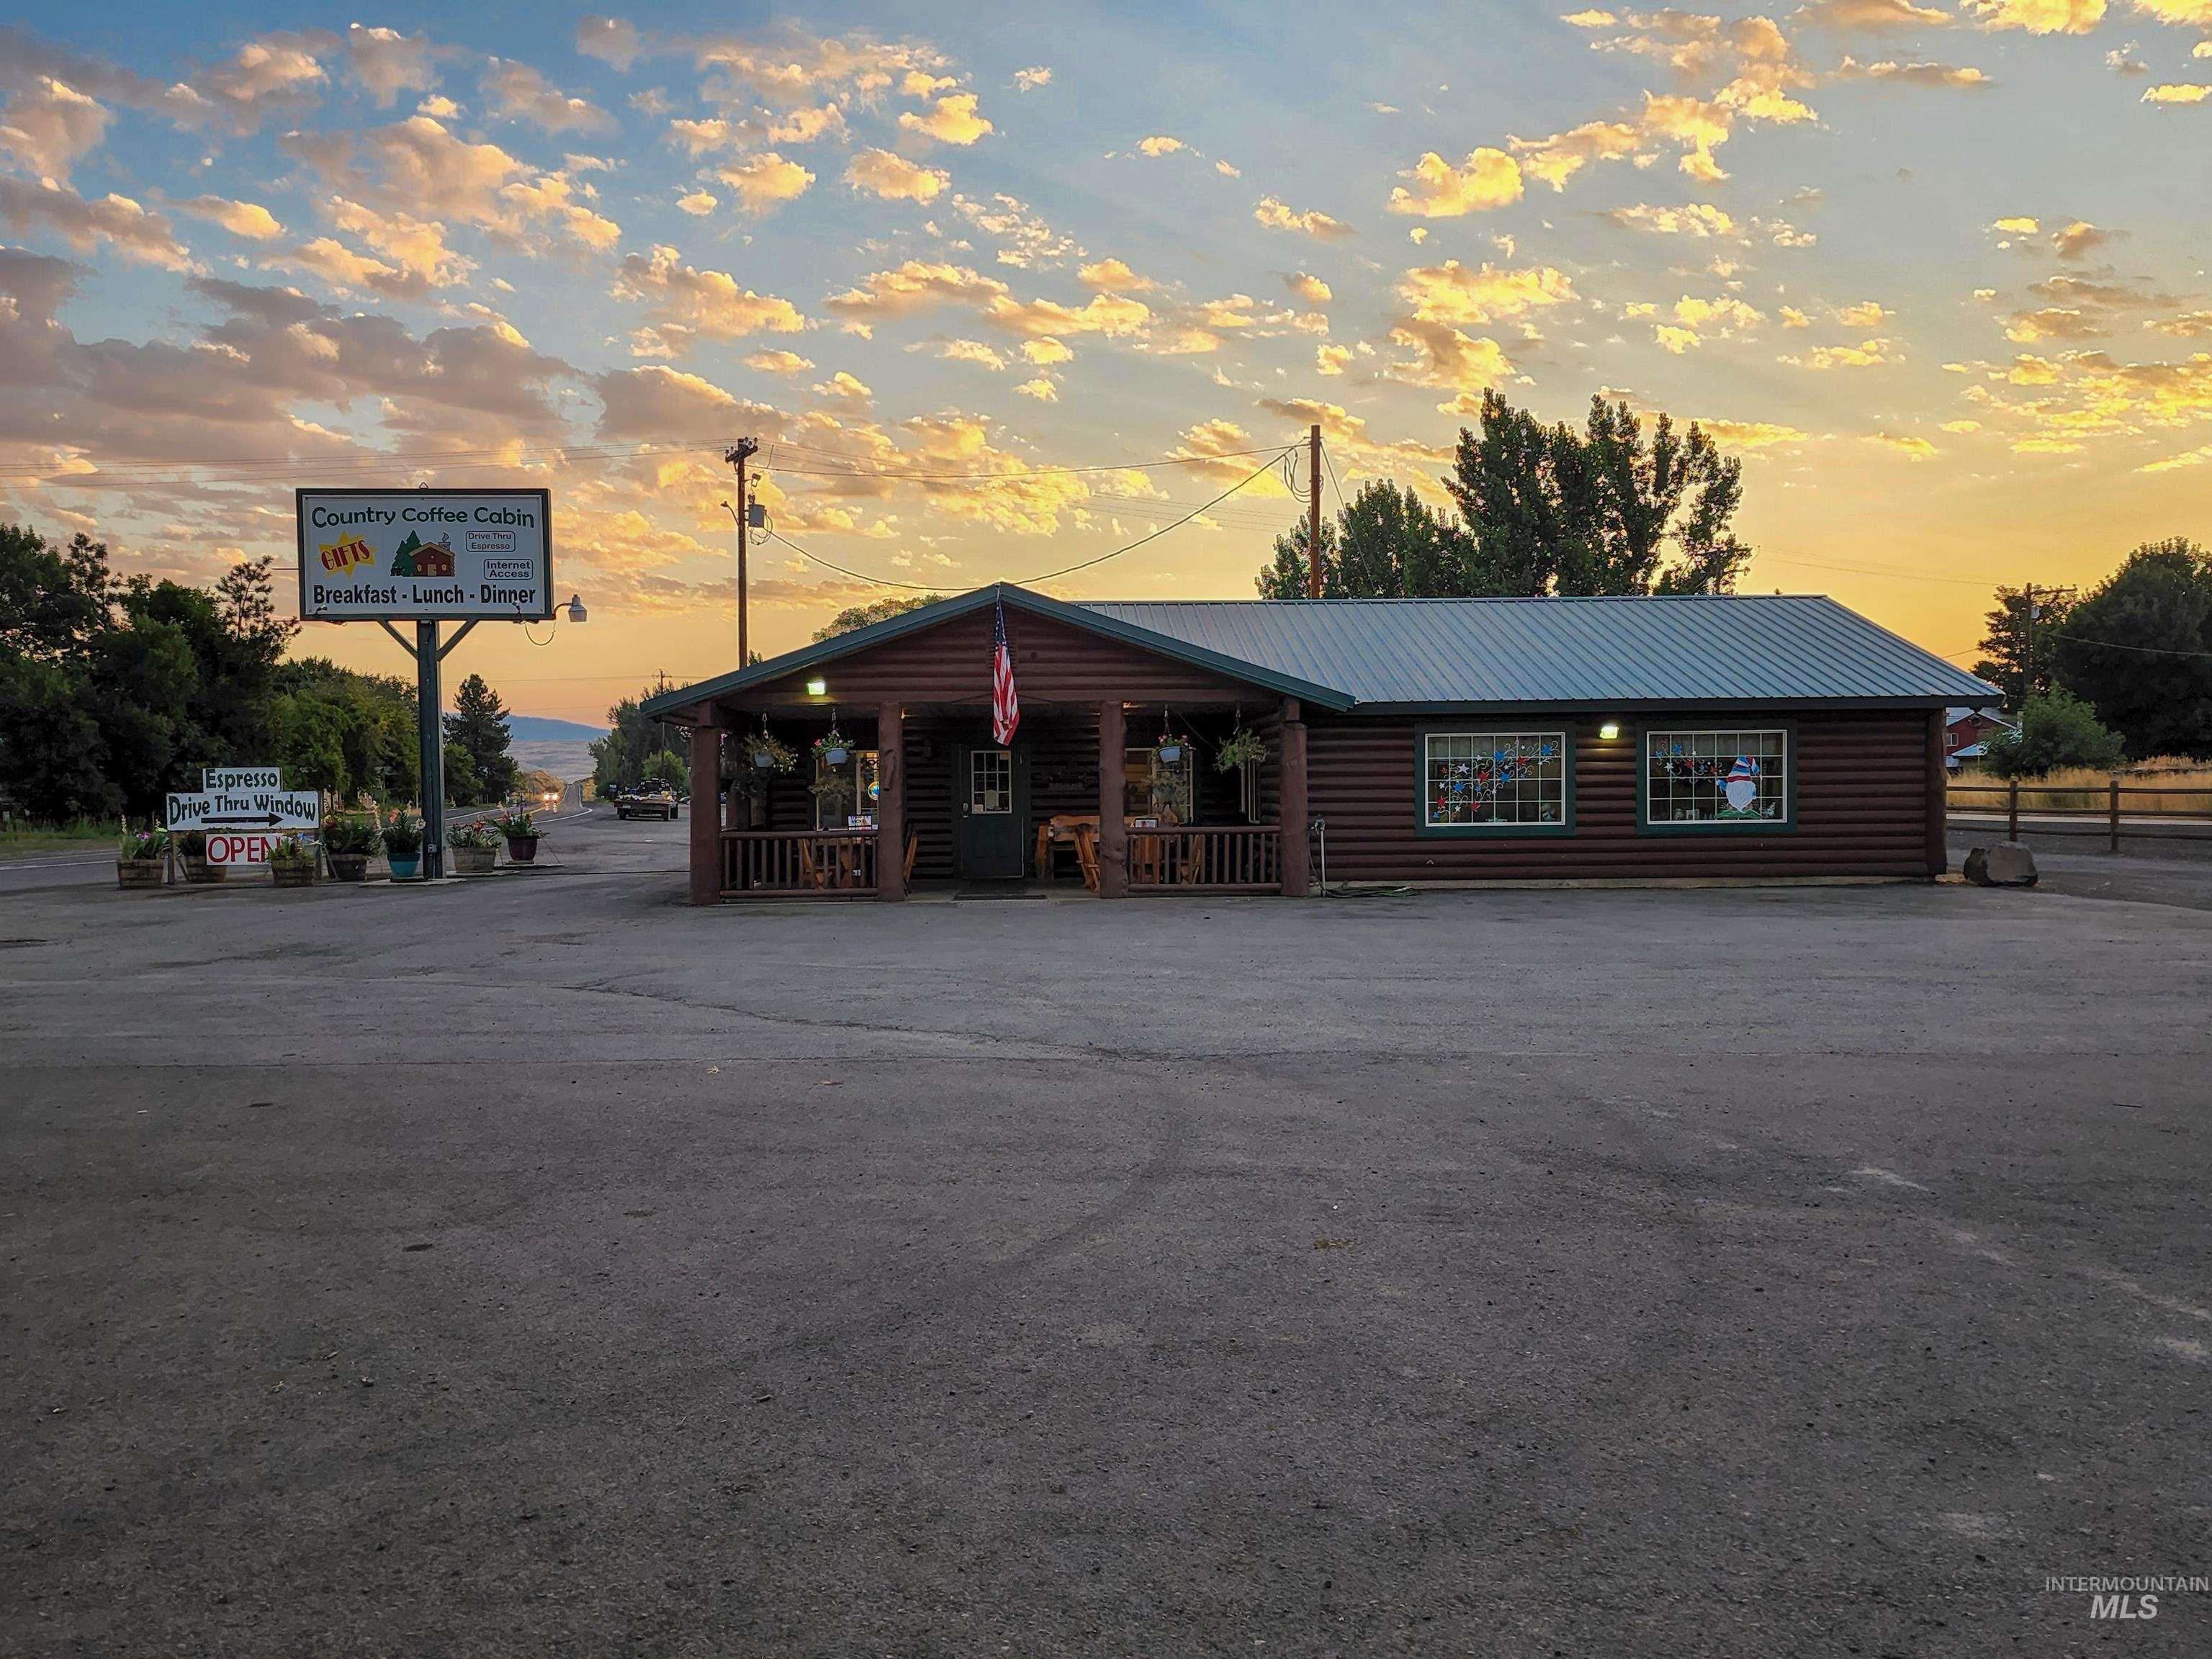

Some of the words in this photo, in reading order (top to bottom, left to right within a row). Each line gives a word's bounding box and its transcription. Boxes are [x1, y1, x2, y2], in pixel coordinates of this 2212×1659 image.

[312, 506, 396, 529] Country
[402, 507, 468, 523] Coffee
[474, 506, 534, 529] Cabin
[321, 539, 371, 571] GIFTS
[487, 561, 531, 570] Internet
[313, 584, 397, 604] Breakfast
[413, 585, 464, 604] Lunch
[480, 584, 536, 604] Dinner
[206, 768, 278, 792] Espresso
[168, 796, 210, 826] Drive
[215, 793, 250, 812] Thru
[253, 793, 316, 822] Window
